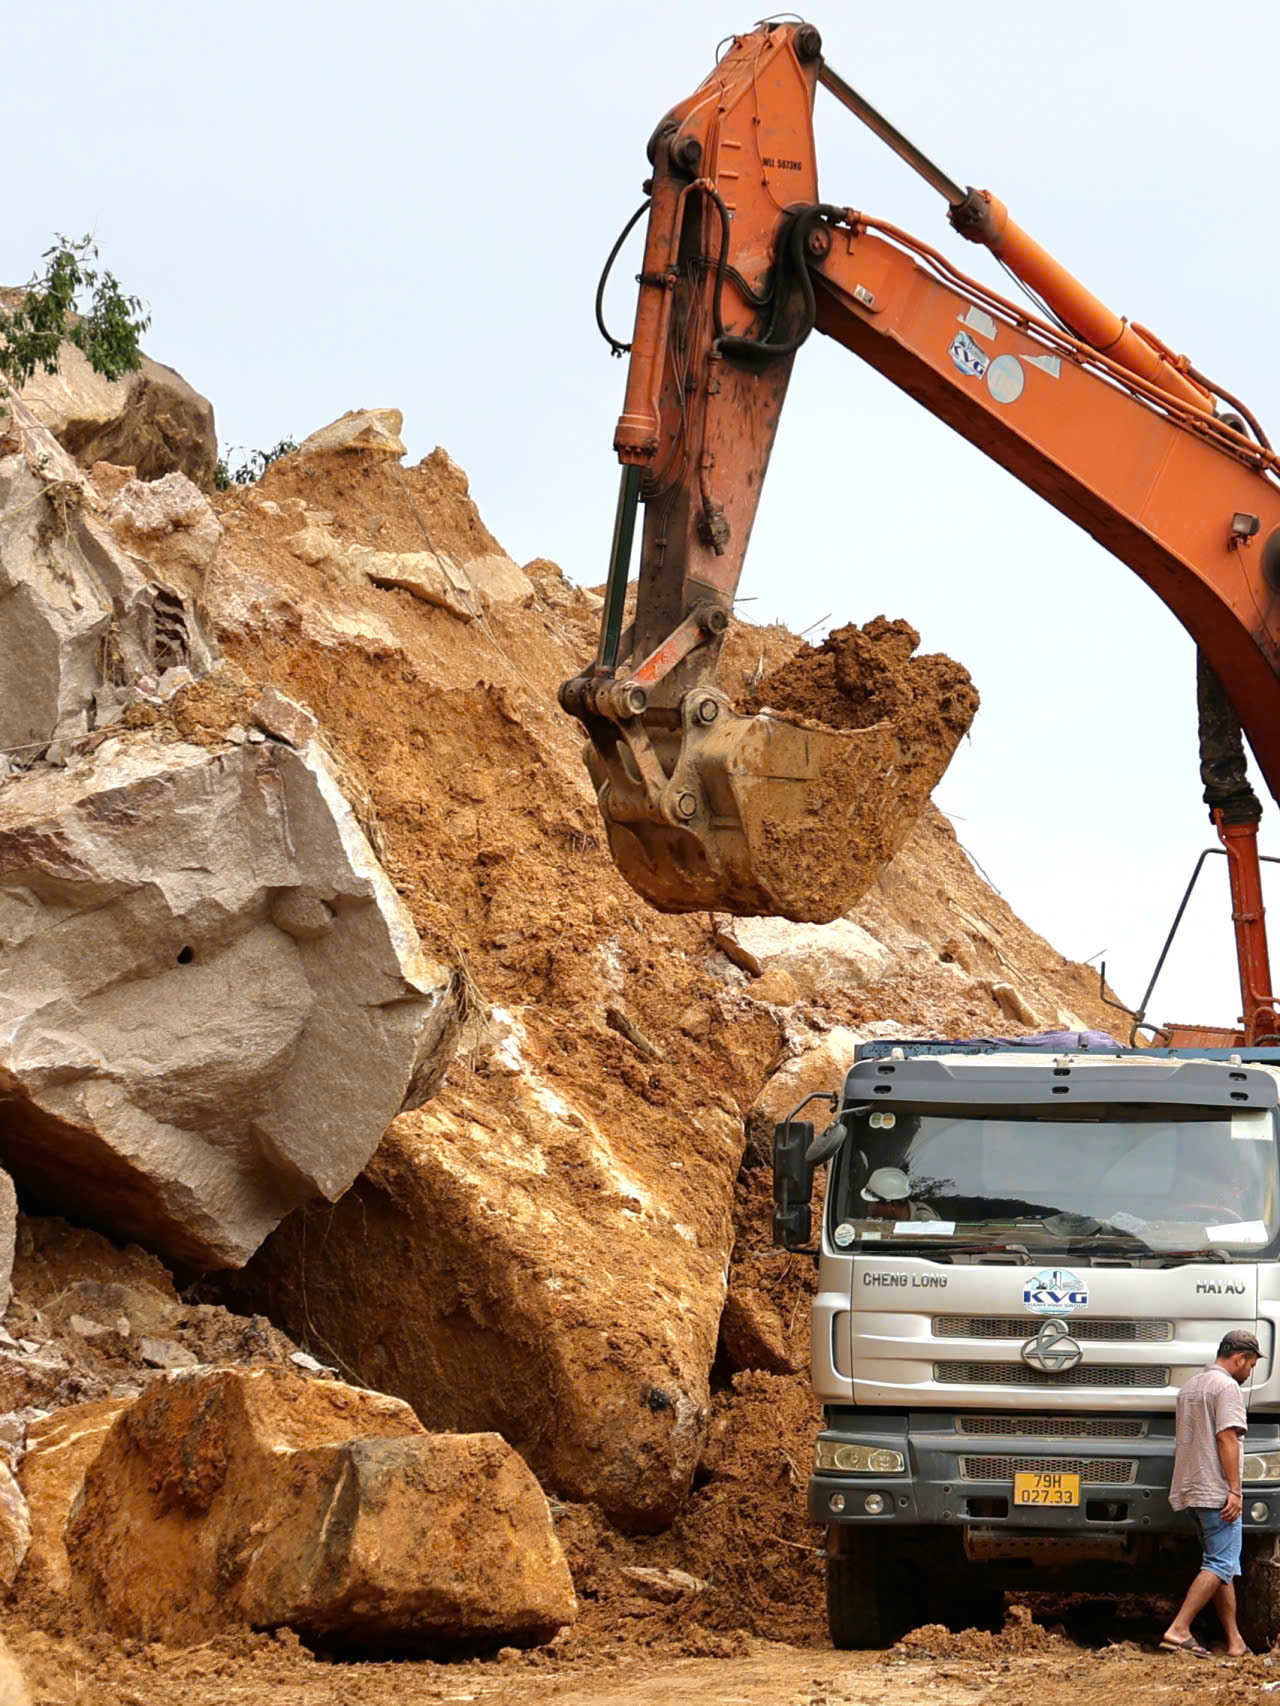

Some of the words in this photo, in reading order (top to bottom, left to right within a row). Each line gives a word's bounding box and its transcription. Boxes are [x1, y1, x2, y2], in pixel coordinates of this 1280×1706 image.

[863, 1272, 908, 1287] CHENG
[912, 1274, 948, 1288] LONG
[1024, 1290, 1088, 1303] KVG
[1033, 1475, 1061, 1488] 79H
[1021, 1489, 1073, 1504] 027.33
